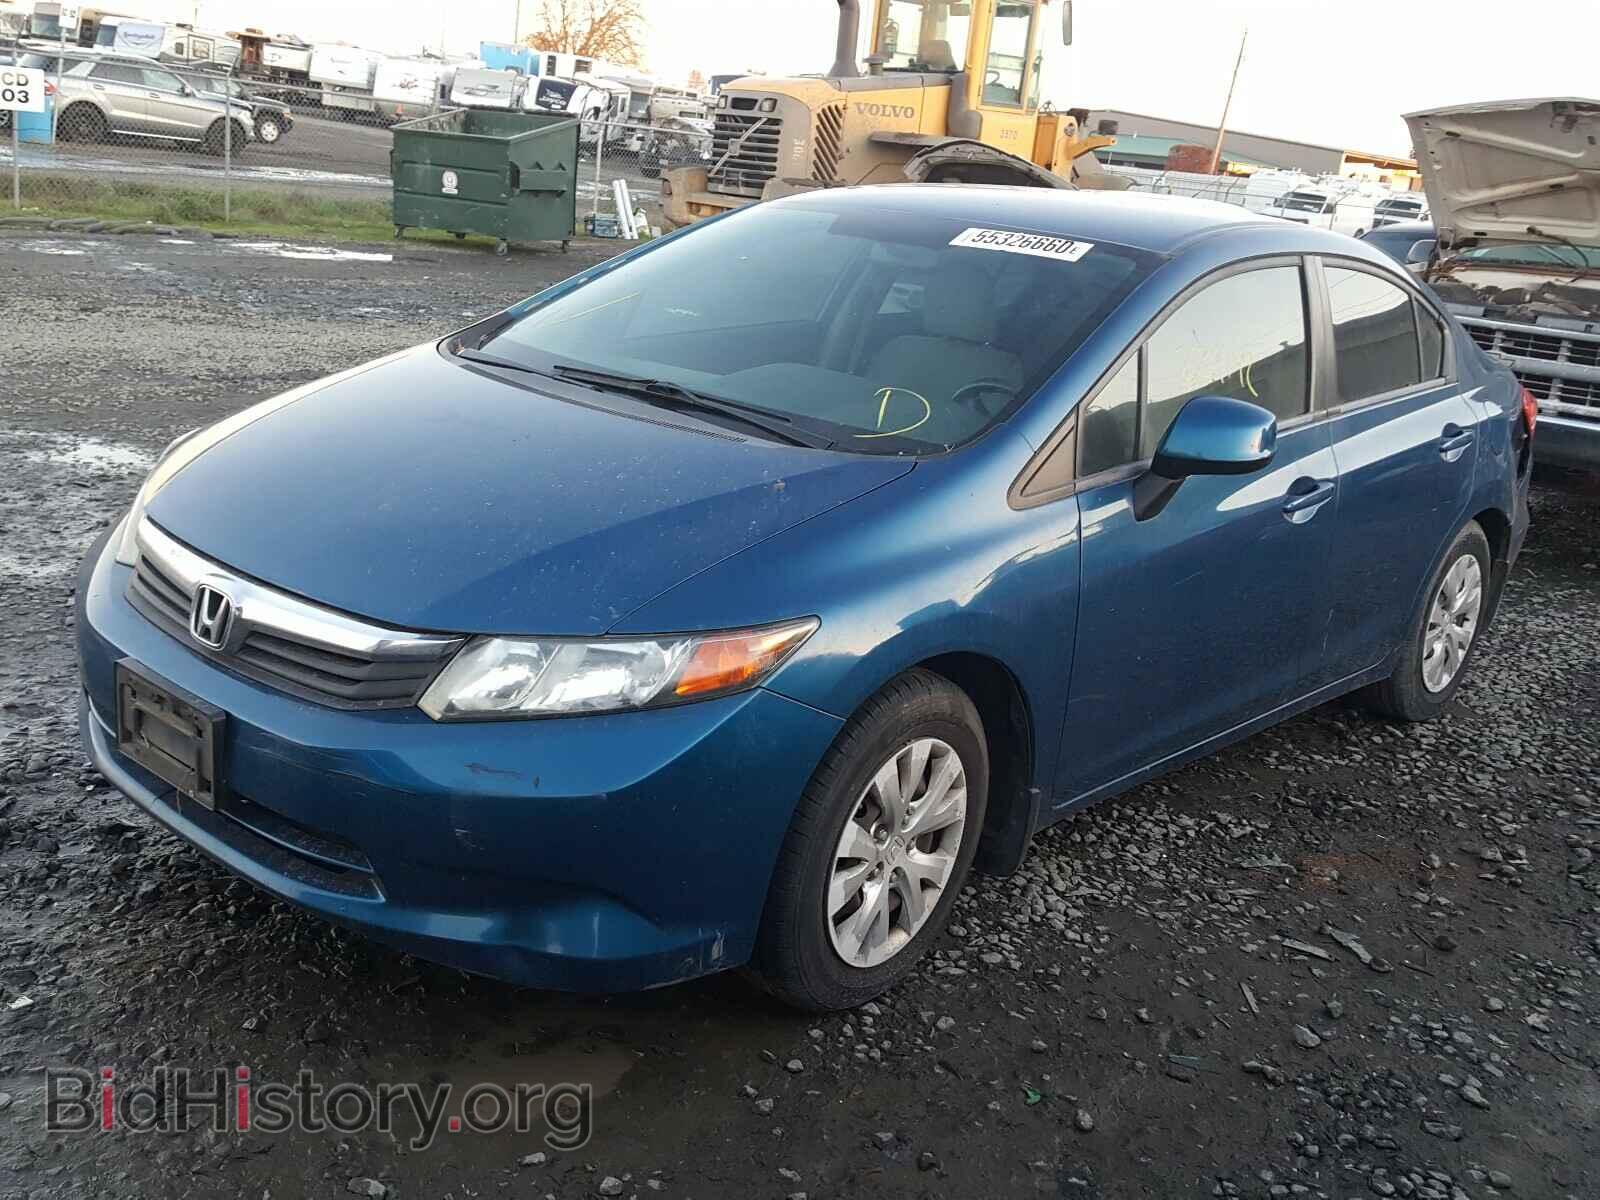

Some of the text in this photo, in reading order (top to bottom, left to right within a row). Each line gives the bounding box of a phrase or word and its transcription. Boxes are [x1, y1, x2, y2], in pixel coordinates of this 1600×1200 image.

[1, 72, 29, 86] CD
[1, 88, 30, 103] 03
[854, 102, 915, 119] VOLVO
[853, 387, 930, 438] D
